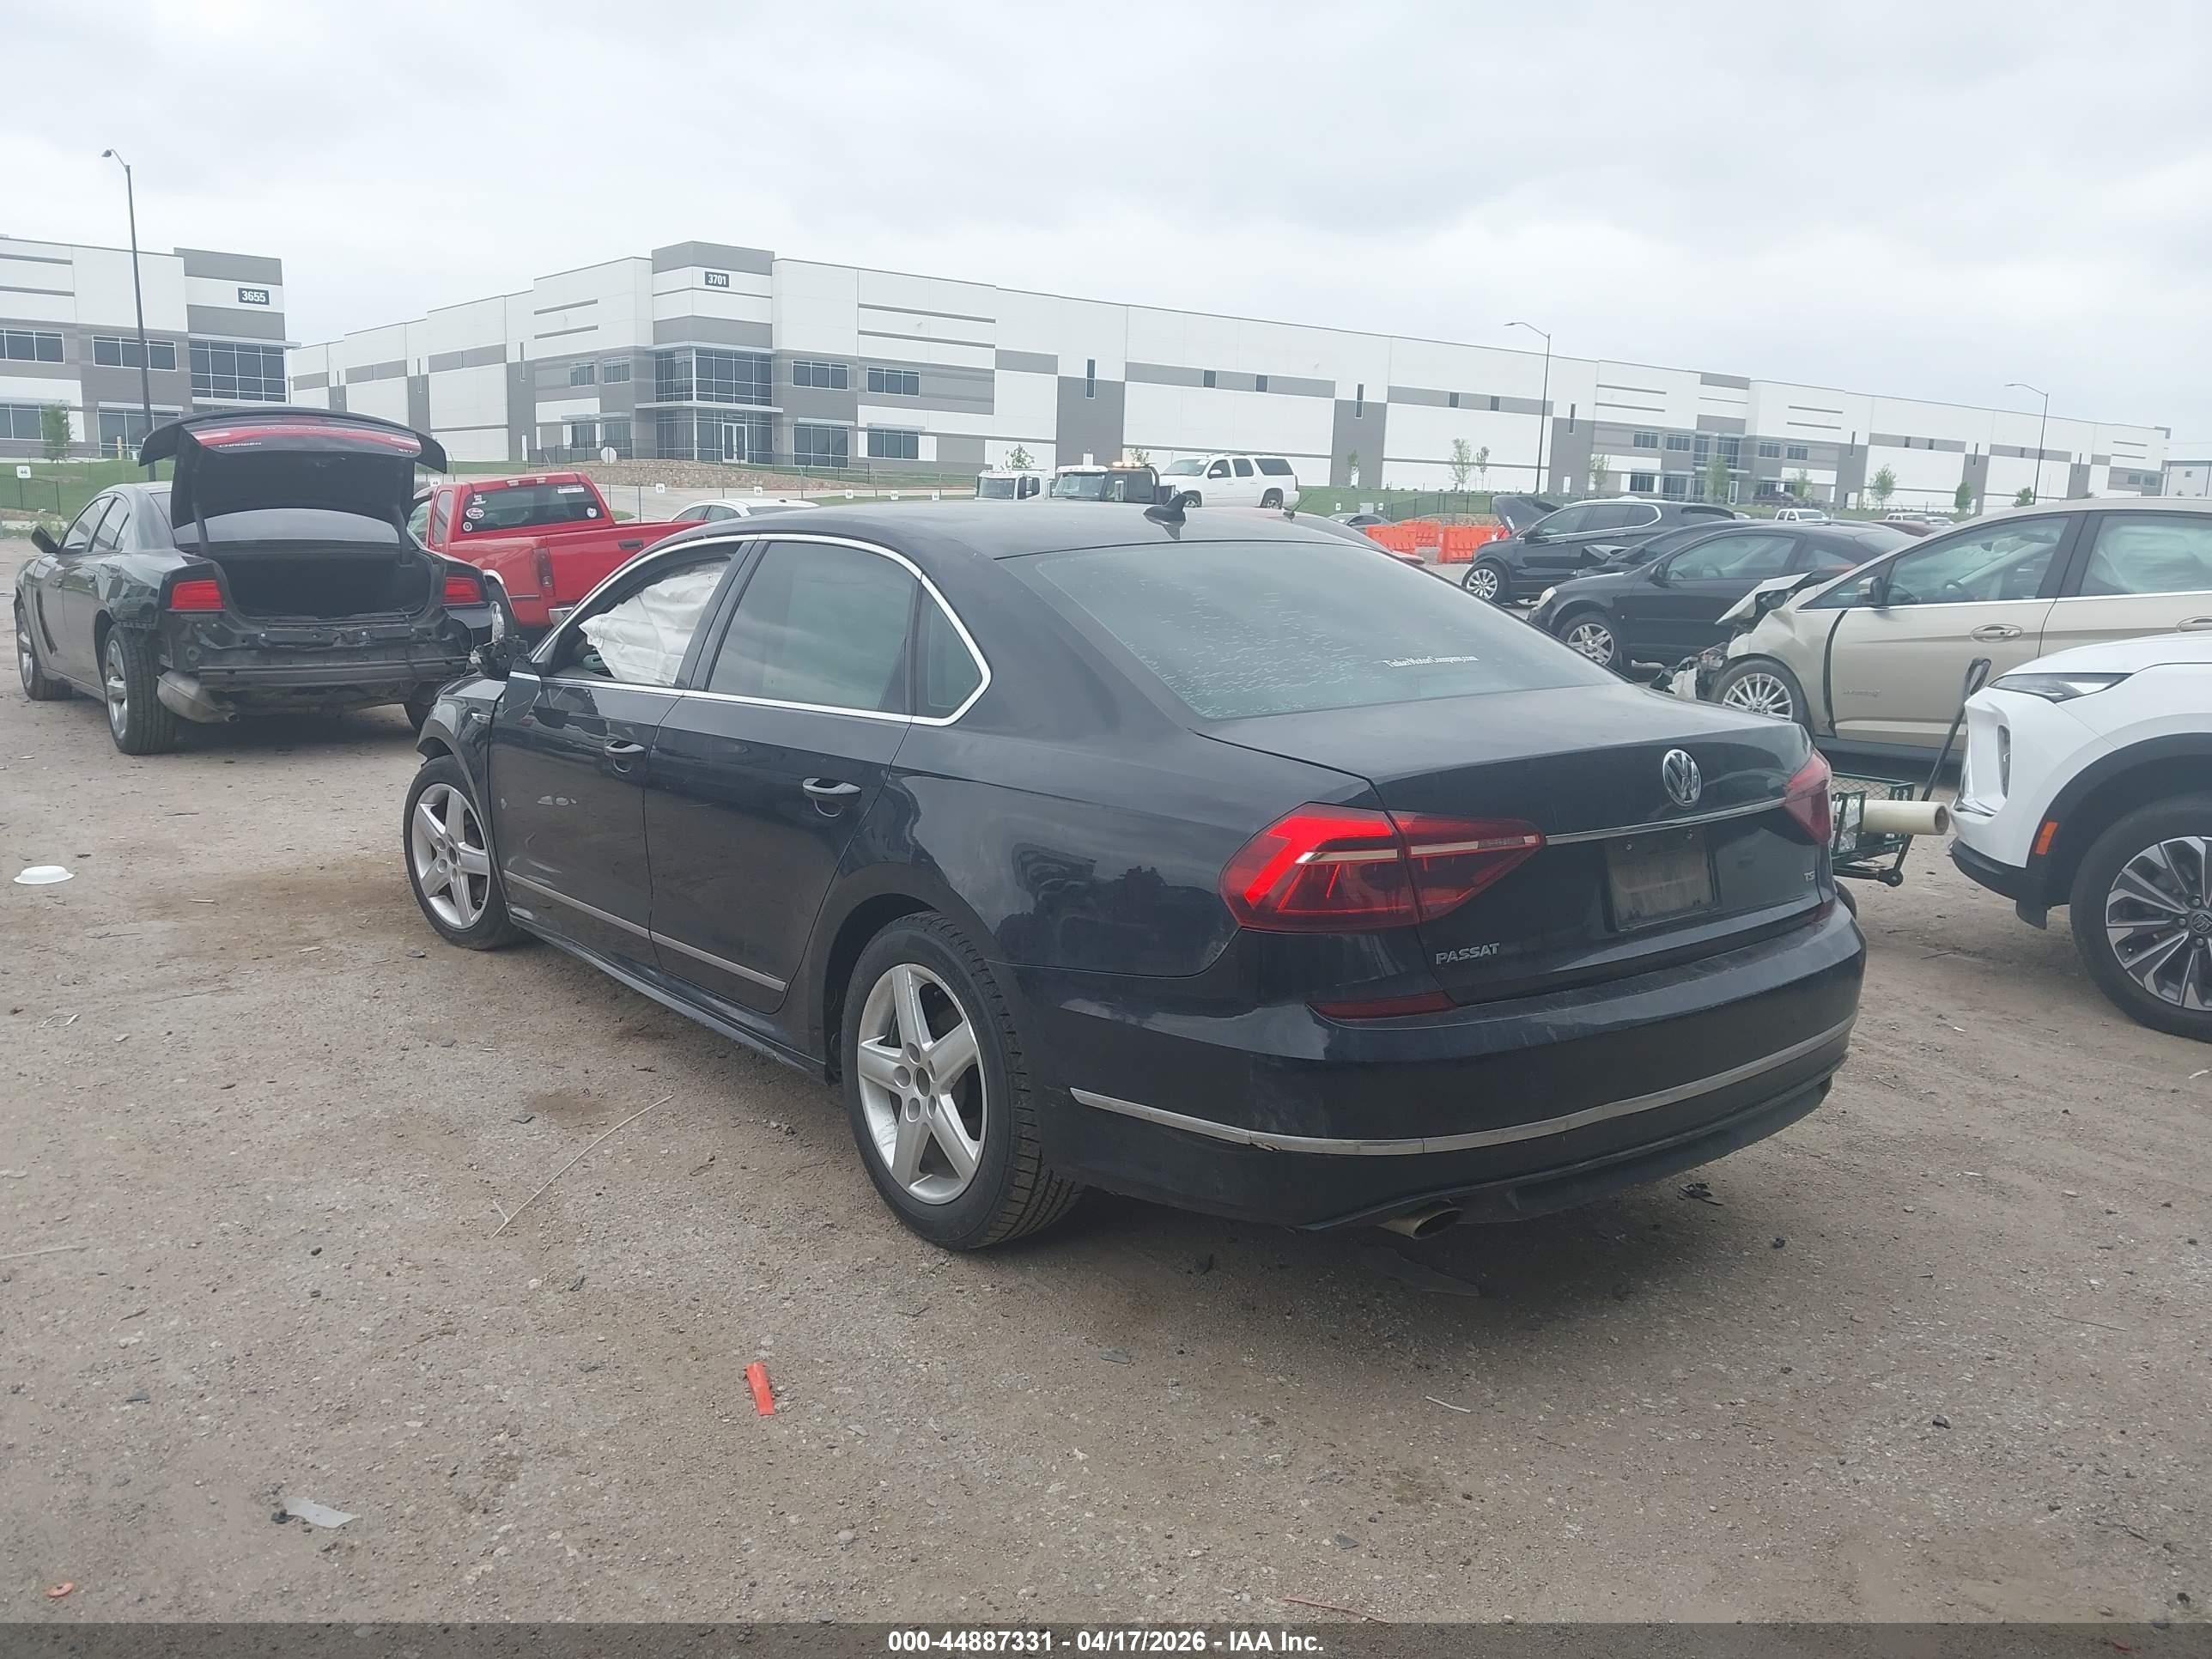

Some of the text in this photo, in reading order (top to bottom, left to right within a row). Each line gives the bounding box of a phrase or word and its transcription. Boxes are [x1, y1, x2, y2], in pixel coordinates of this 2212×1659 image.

[708, 274, 726, 285] 3701
[241, 290, 266, 303] 3655
[1436, 942, 1500, 965] PASSAT
